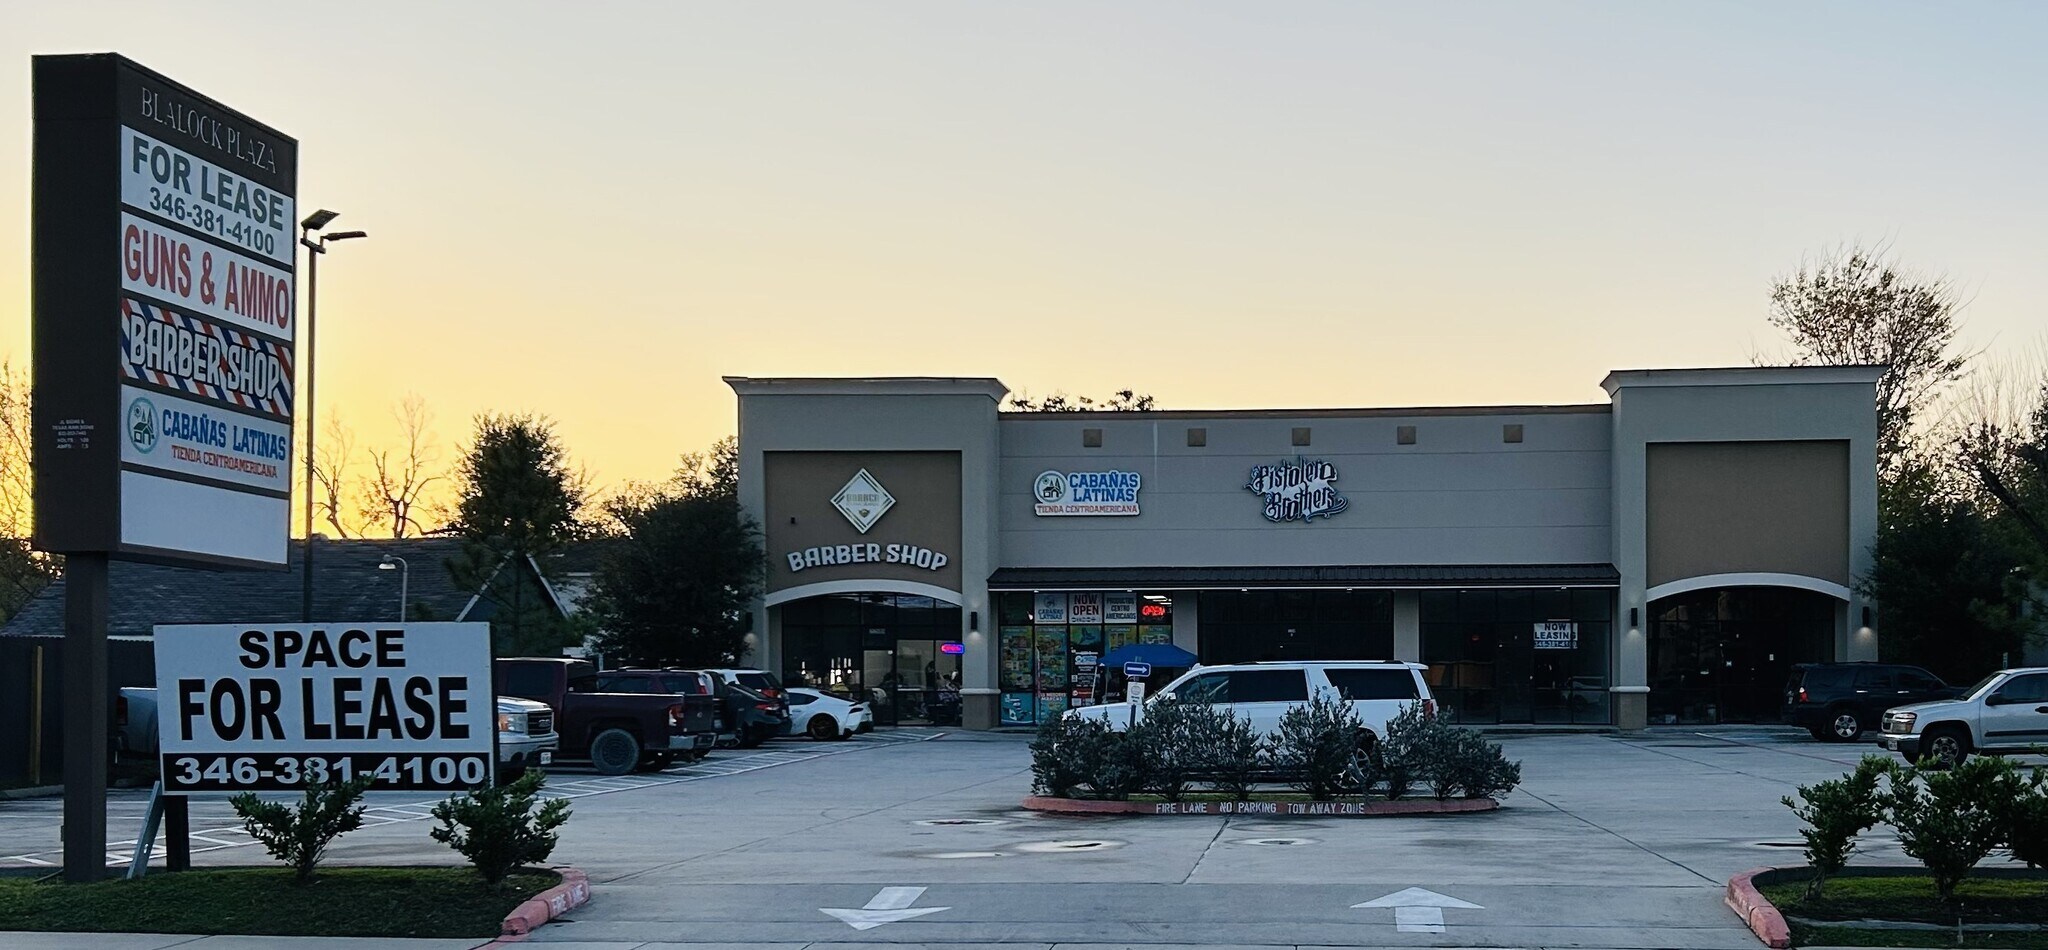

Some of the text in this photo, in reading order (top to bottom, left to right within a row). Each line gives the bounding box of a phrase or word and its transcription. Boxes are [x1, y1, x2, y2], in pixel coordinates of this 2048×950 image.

[142, 87, 276, 174] BLALOCK PLAZA
[133, 135, 284, 231] FOR LEASE
[149, 187, 274, 255] 346-381-4100
[124, 224, 289, 330] GUNS & AMMO
[129, 313, 280, 400] BARBER SHOP
[162, 409, 287, 461] CABAÑAS LATINAS
[171, 445, 278, 478] TIENDA CENTROAMERICANA
[1247, 455, 1337, 494] Pistolero
[1069, 472, 1138, 488] CABAÑAS
[1073, 489, 1134, 502] LATINAS
[1037, 505, 1137, 513] TIENDA CENTROAMERICANA
[1263, 481, 1337, 521] Brothers
[787, 543, 948, 572] BARBER SHOP
[1073, 605, 1099, 616] OPEN
[1074, 594, 1098, 605] NOW
[1142, 605, 1166, 616] OPEN
[1544, 623, 1566, 631] NOW
[239, 629, 406, 668] SPACE
[178, 676, 470, 741] FOR LEASE
[175, 756, 486, 784] 346-381-4100
[1156, 802, 1365, 814] FIRE LANE NO PARKING TOW AWAY ZONE
